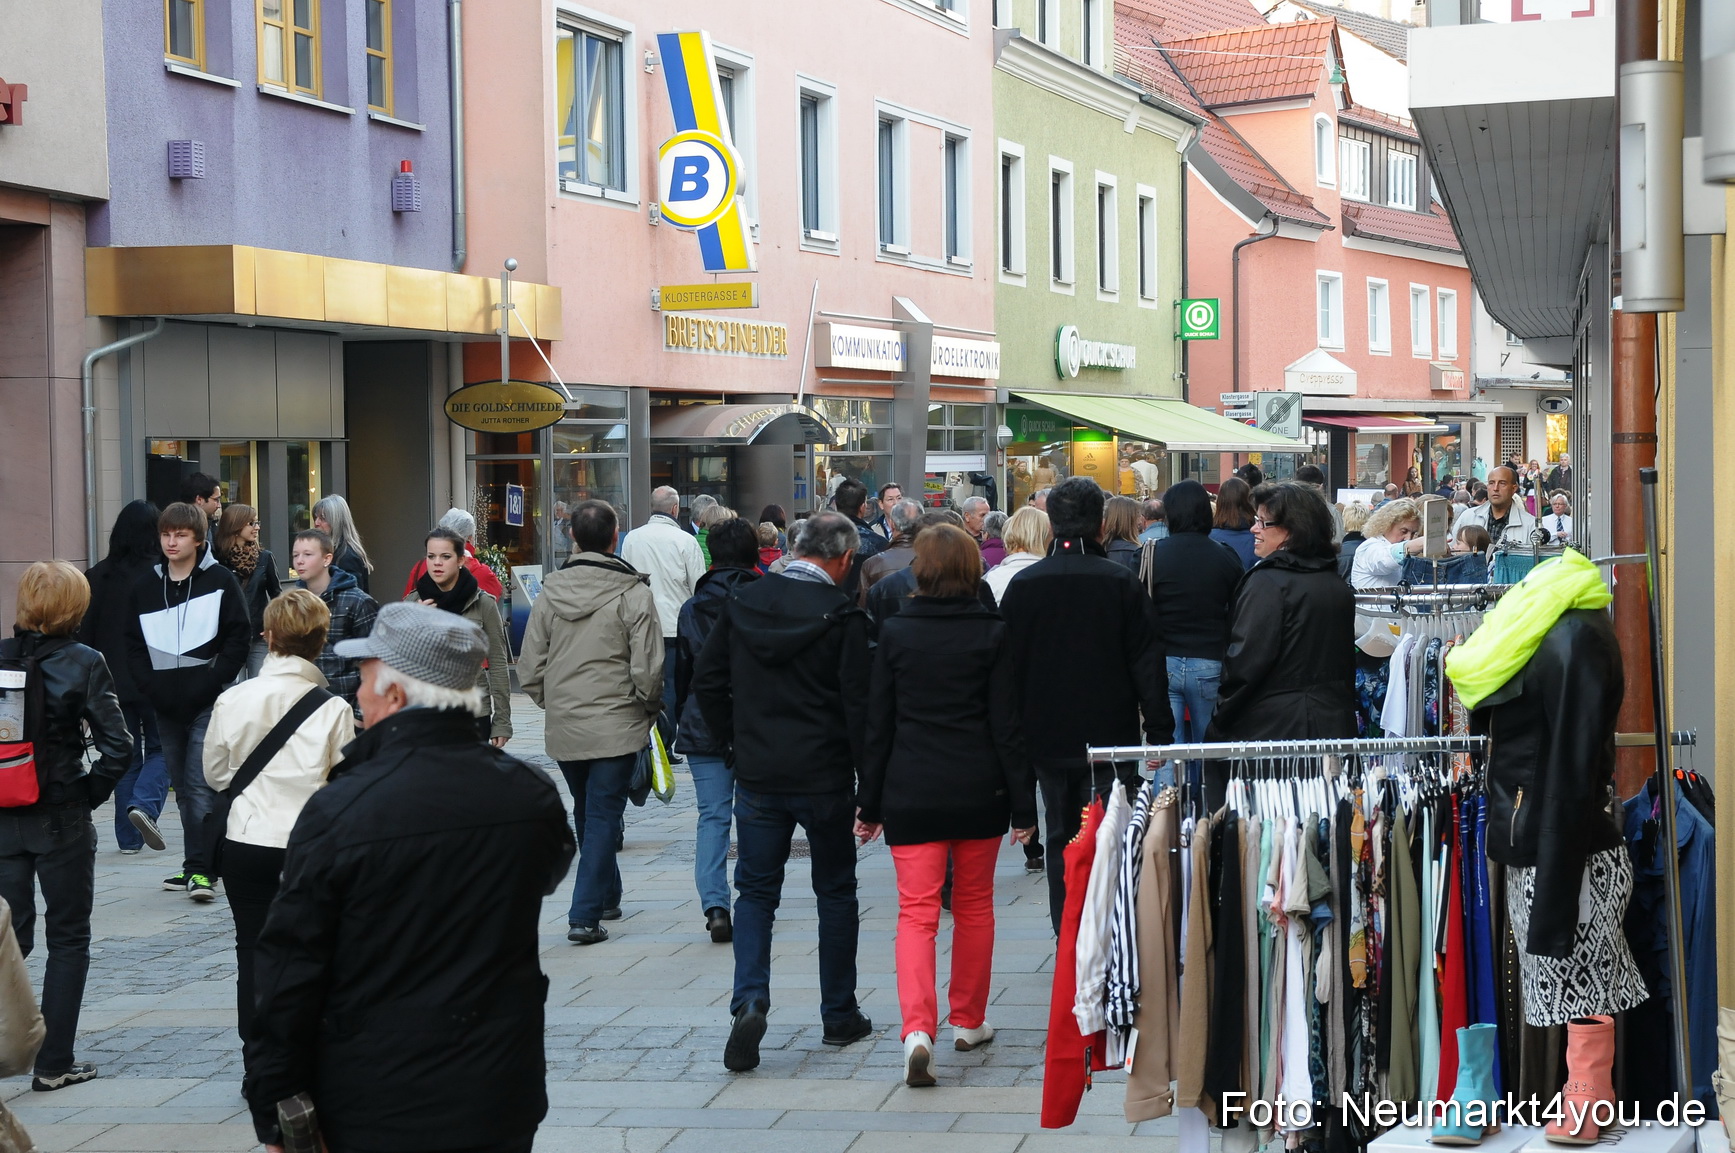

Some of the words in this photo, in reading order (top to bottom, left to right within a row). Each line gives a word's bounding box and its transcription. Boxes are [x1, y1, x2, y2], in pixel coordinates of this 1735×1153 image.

[668, 155, 710, 202] B
[665, 290, 738, 303] KLOSTERGASSE
[741, 289, 747, 300] 4
[665, 314, 788, 356] BRETSCHNEIDER
[831, 335, 907, 362] KOMMUNIKATION
[932, 341, 999, 370] ÜROELEKTRONIK
[451, 403, 471, 413] DIE
[473, 402, 562, 413] GOLDSCHMIEDE
[1221, 393, 1250, 401] Klostergasse
[1271, 426, 1289, 435] ONE
[508, 494, 522, 515] 1&1
